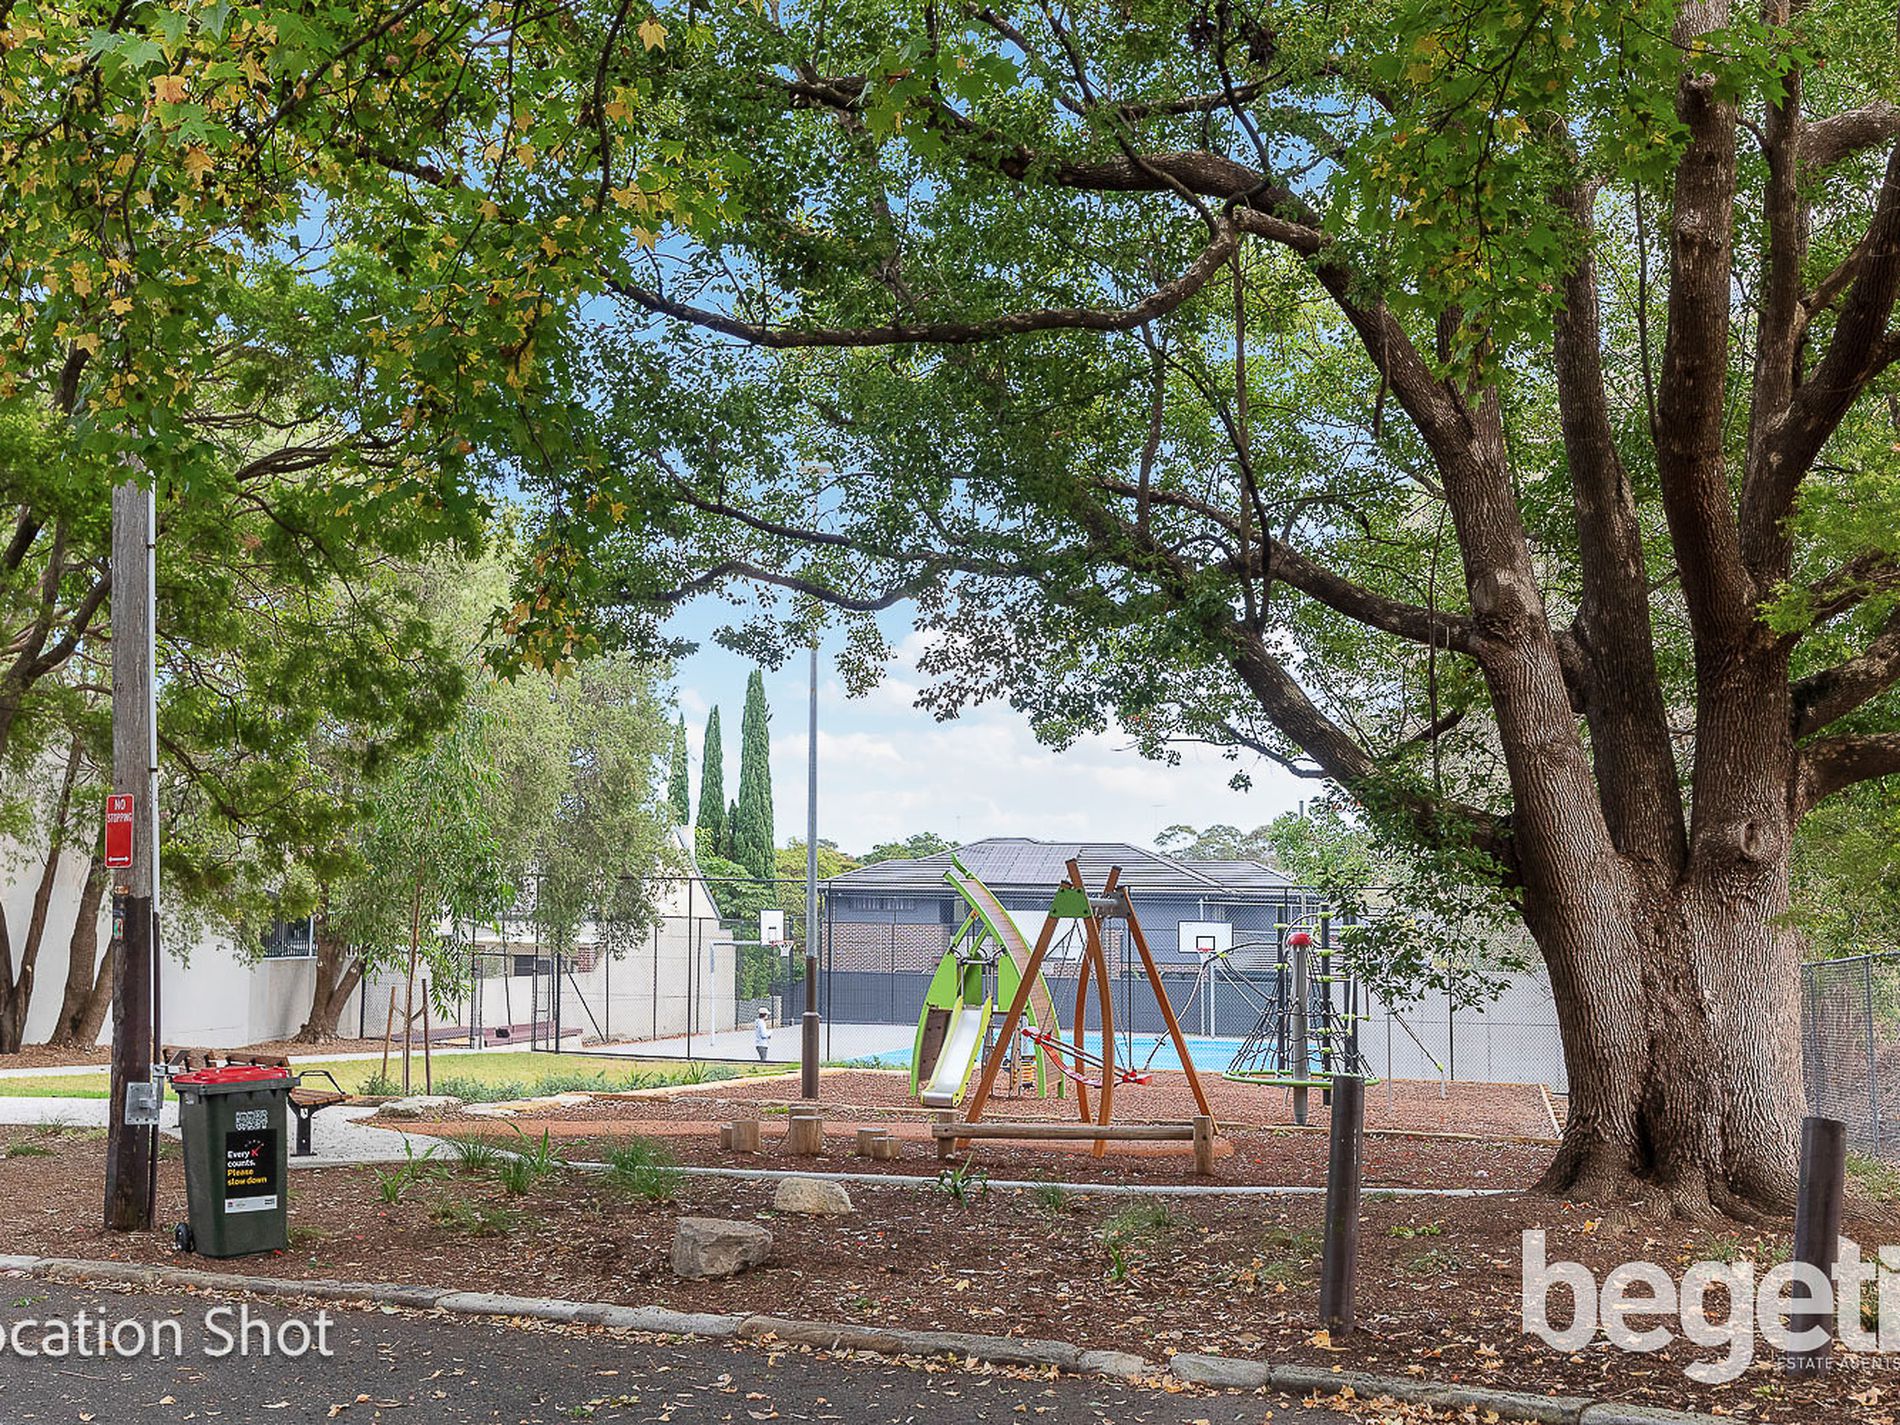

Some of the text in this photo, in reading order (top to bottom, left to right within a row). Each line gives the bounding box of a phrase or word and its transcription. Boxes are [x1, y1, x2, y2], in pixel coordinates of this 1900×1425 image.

[114, 799, 126, 810] NO
[107, 812, 132, 823] STOPPING
[227, 1151, 250, 1159] Every
[227, 1176, 268, 1186] slow down
